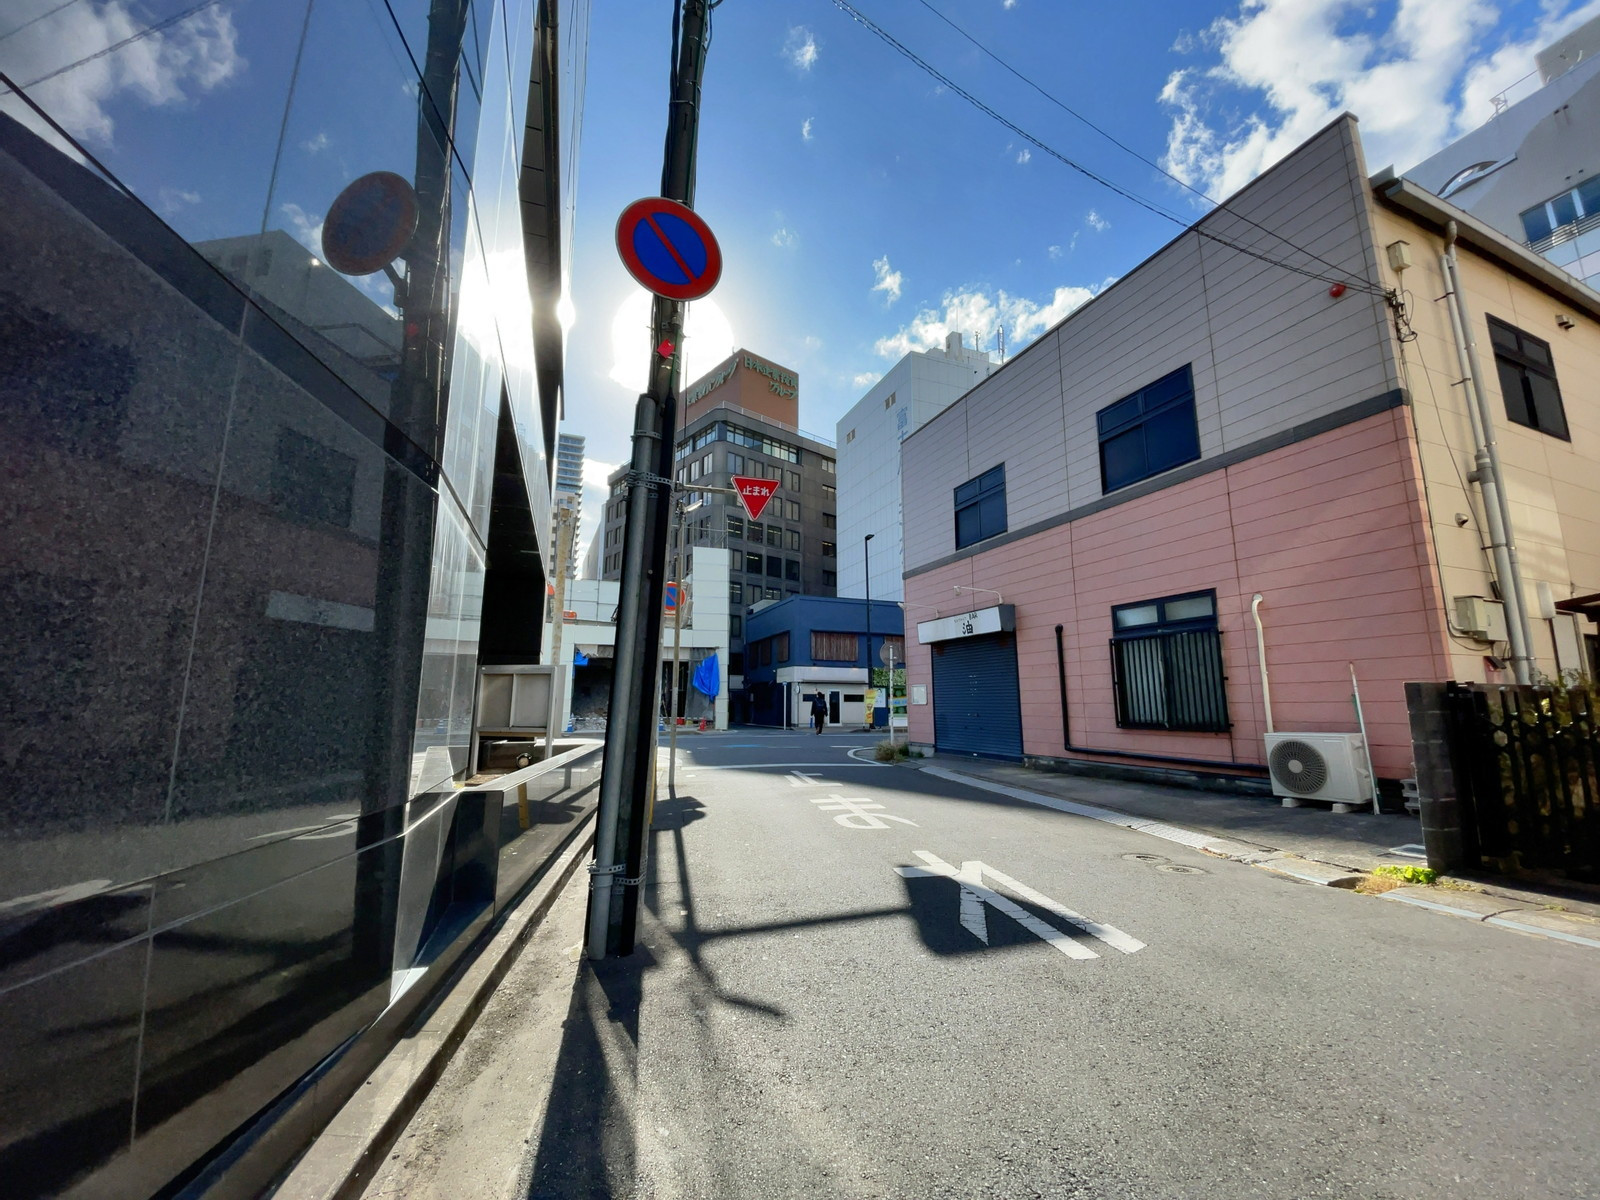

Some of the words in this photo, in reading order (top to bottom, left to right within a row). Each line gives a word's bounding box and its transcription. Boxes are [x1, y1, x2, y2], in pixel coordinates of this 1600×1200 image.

[742, 485, 770, 497] 止まれ
[961, 620, 974, 635] 油
